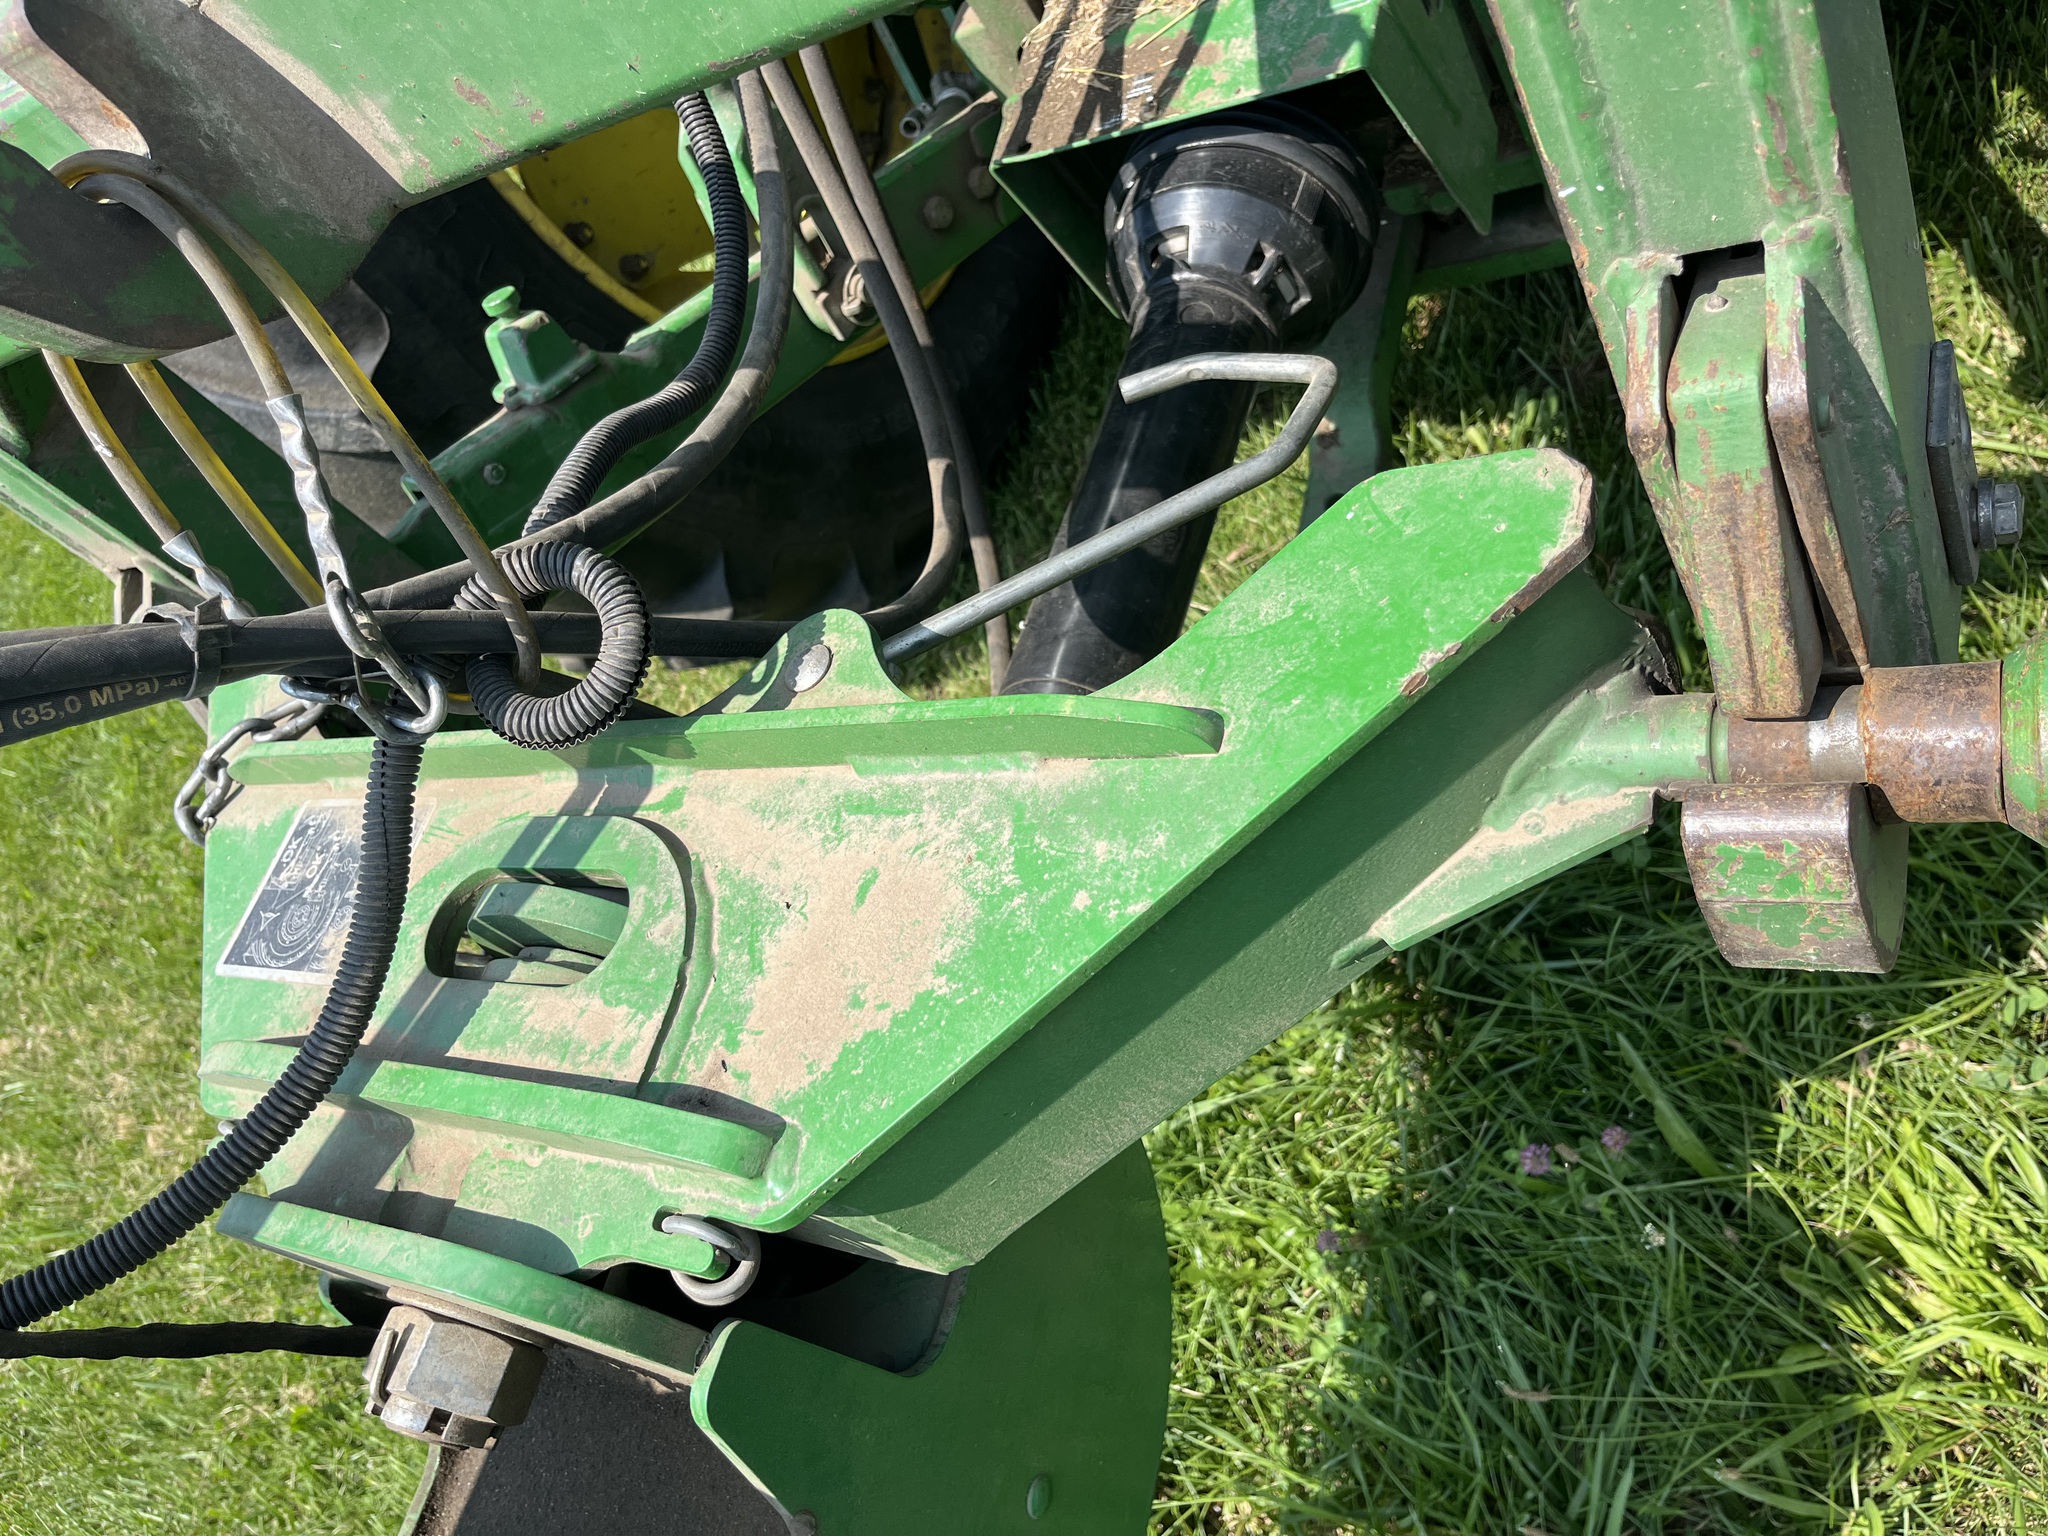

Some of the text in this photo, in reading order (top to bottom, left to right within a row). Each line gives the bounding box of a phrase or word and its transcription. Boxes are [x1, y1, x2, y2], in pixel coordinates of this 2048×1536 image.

[12, 695, 82, 730] (35,0
[89, 677, 160, 708] MPa)
[281, 836, 303, 863] OK
[306, 853, 326, 879] OK
